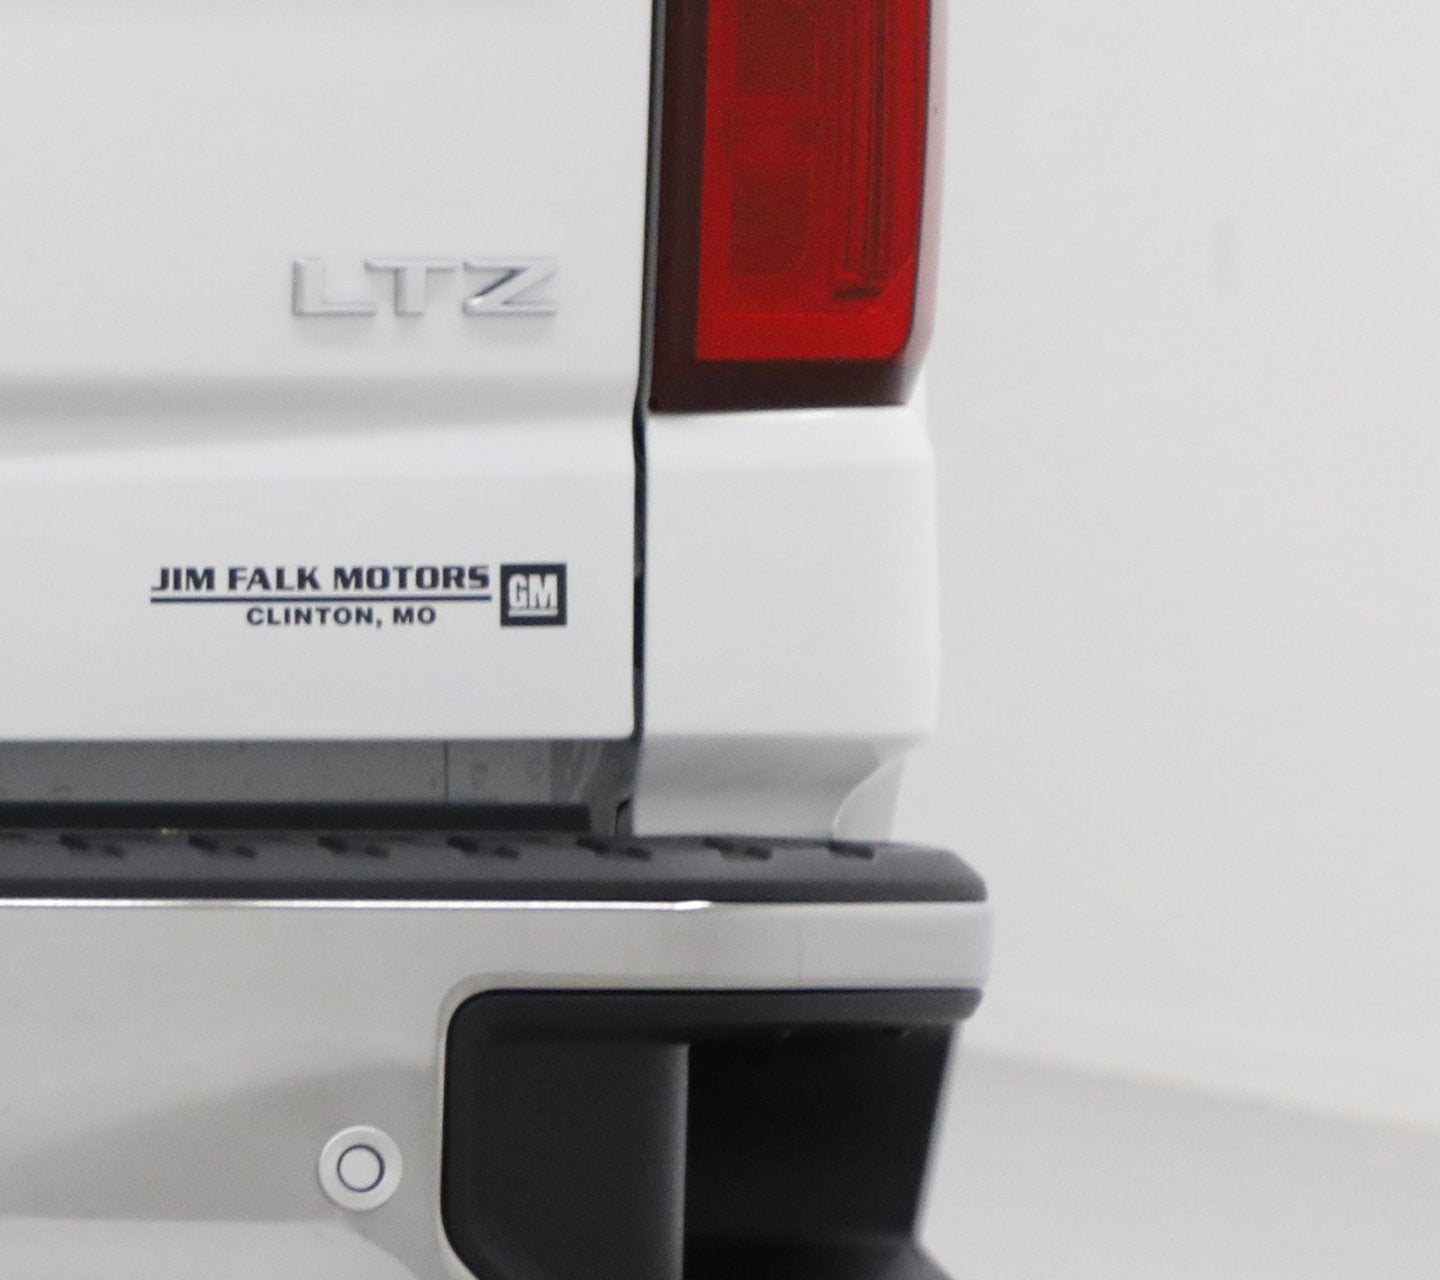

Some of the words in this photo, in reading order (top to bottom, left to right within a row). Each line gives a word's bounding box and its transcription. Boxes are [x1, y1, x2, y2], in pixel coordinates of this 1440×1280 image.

[291, 256, 558, 319] LTZ
[151, 566, 215, 591] JIM
[227, 566, 321, 591] FALK
[332, 565, 490, 590] MOTORS
[246, 606, 383, 629] CLINTON,
[392, 606, 437, 626] MO
